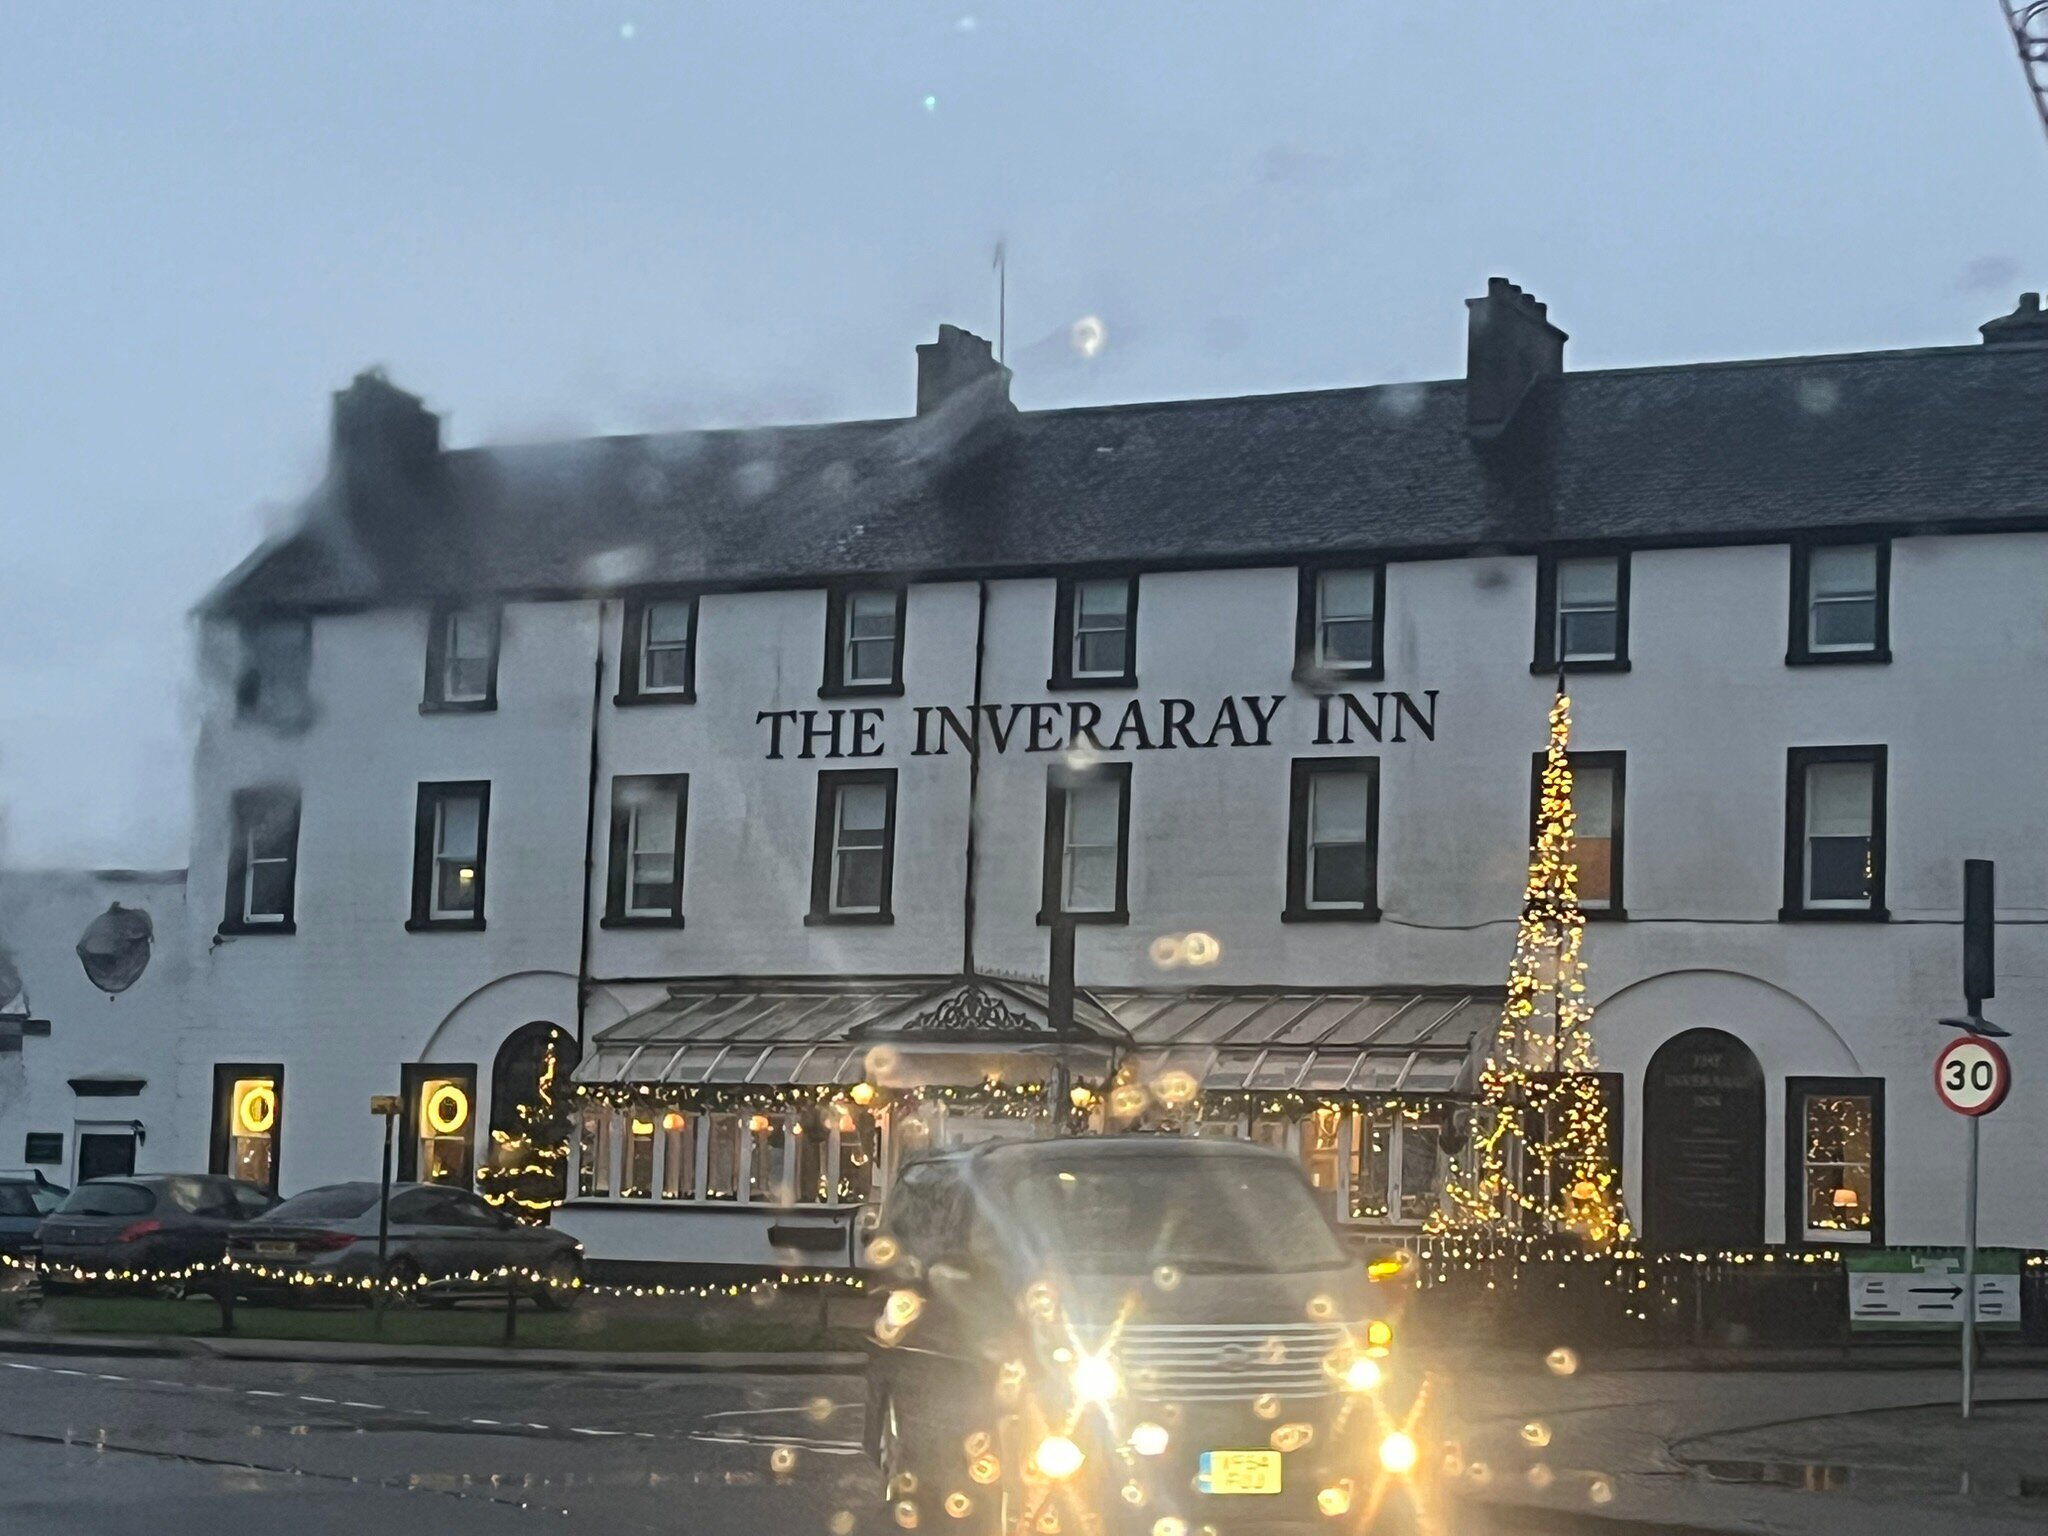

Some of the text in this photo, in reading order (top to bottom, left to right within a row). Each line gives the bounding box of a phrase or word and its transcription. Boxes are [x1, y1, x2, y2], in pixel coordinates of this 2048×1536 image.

[756, 690, 1440, 759] THE INVERARAY INN
[1946, 1060, 1993, 1091] 30
